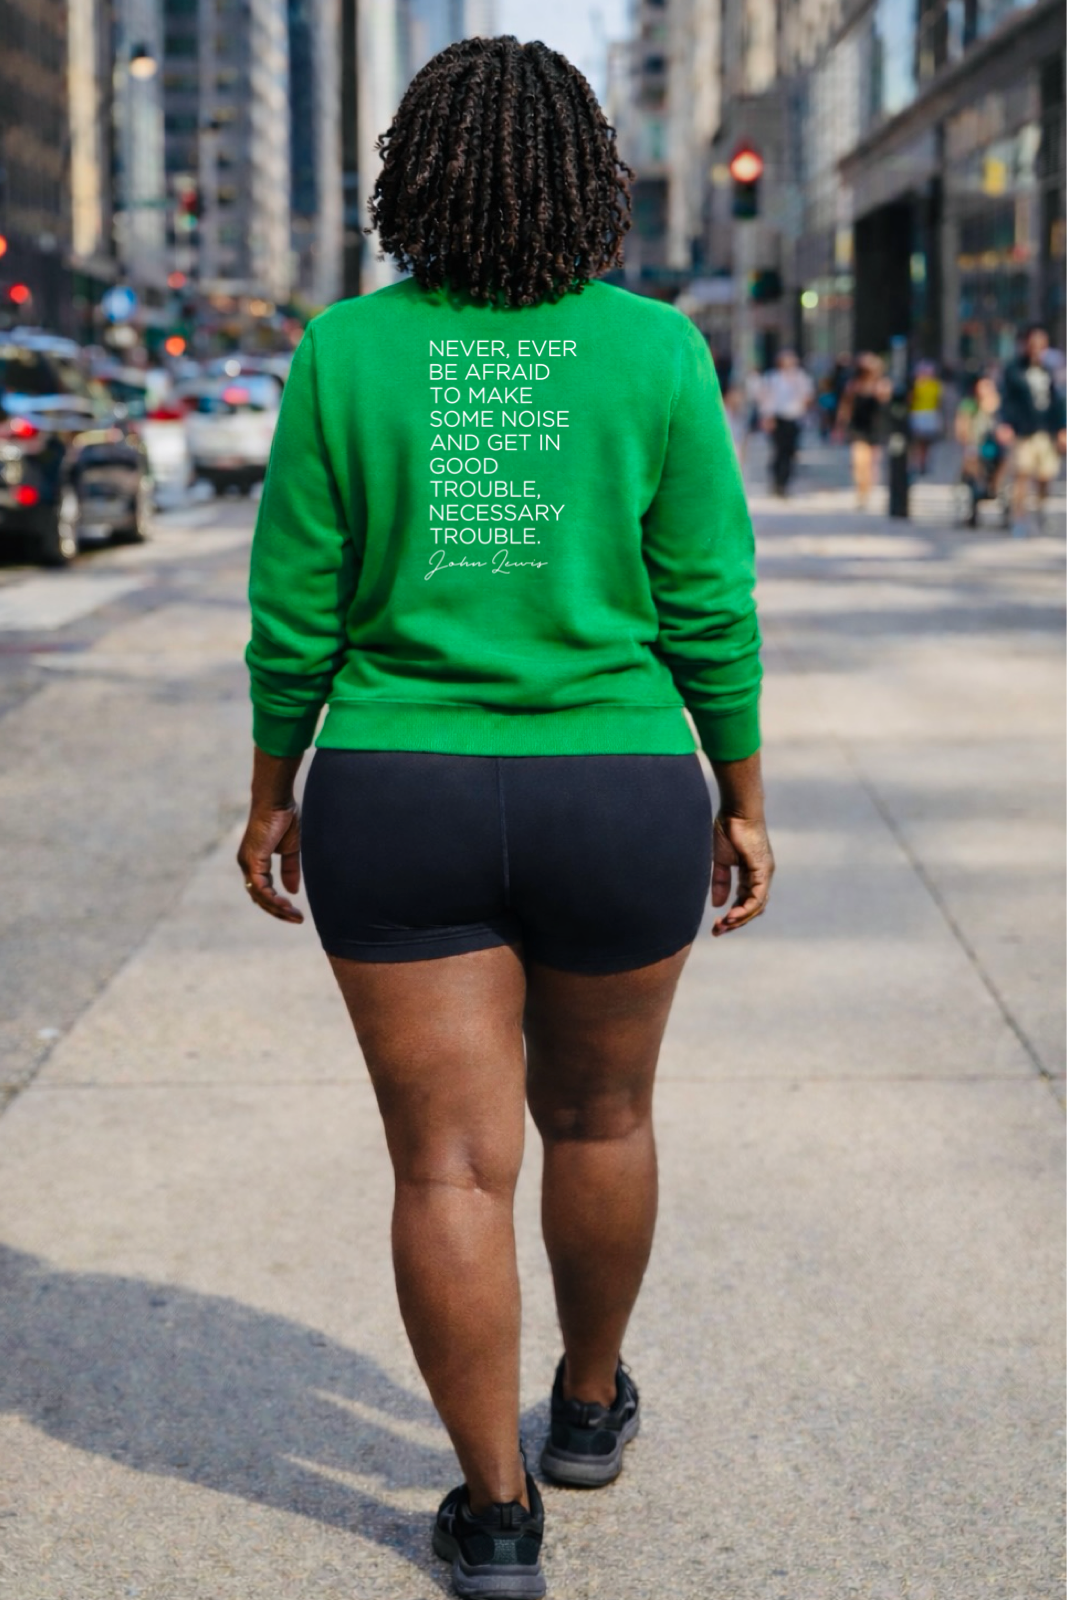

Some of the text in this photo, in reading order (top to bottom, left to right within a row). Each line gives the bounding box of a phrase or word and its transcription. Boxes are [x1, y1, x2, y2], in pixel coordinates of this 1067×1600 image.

[429, 340, 577, 359] NEVER, EVER
[429, 363, 550, 381] BE AFRAID
[429, 387, 533, 404] TO MAKE
[429, 410, 570, 428] SOME NOISE
[429, 434, 560, 451] AND GET IN
[429, 457, 499, 475] GOOD
[429, 480, 541, 500] TROUBLE,
[429, 504, 565, 522] NECESSARY
[429, 527, 541, 545] TROUBLE.
[424, 548, 549, 581] John Lewis
